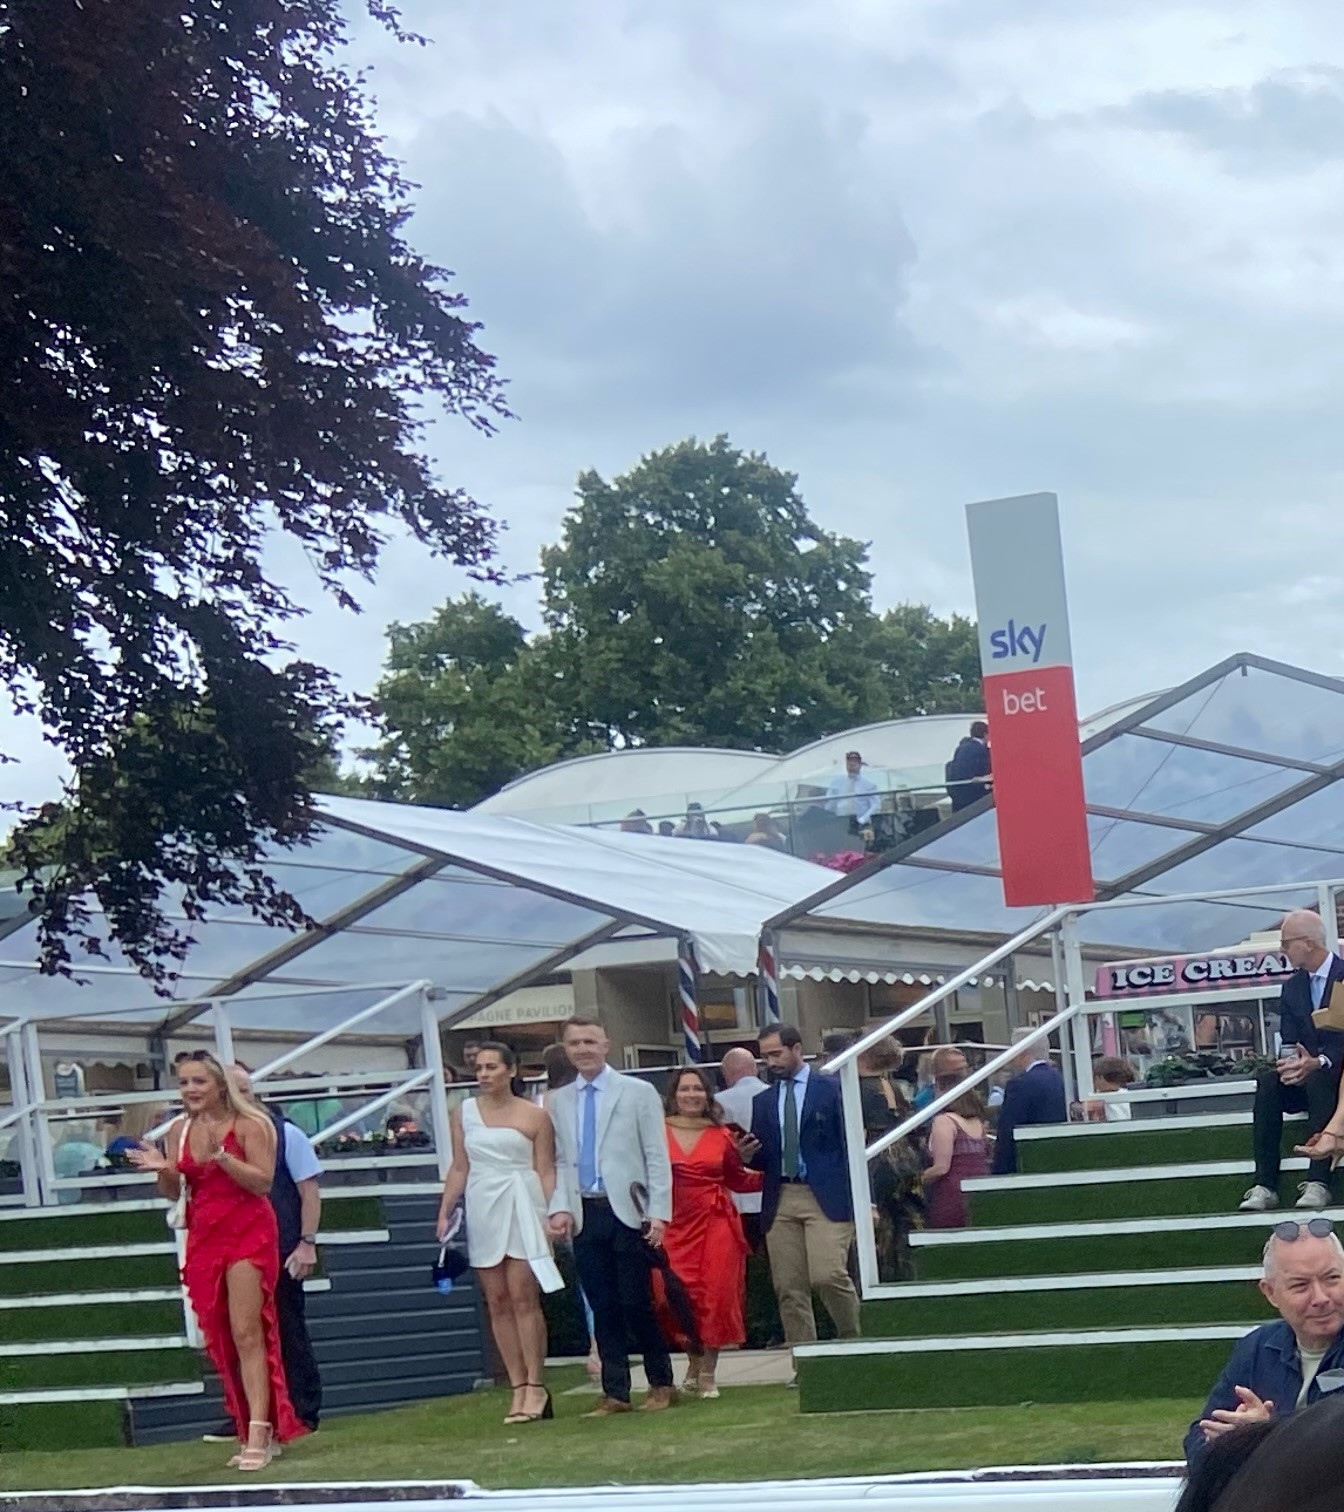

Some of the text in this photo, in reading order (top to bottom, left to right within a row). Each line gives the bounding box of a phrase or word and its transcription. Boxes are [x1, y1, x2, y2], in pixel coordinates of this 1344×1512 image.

[990, 619, 1047, 663] sky
[1003, 687, 1047, 715] bet
[1113, 954, 1295, 989] ICE CREA
